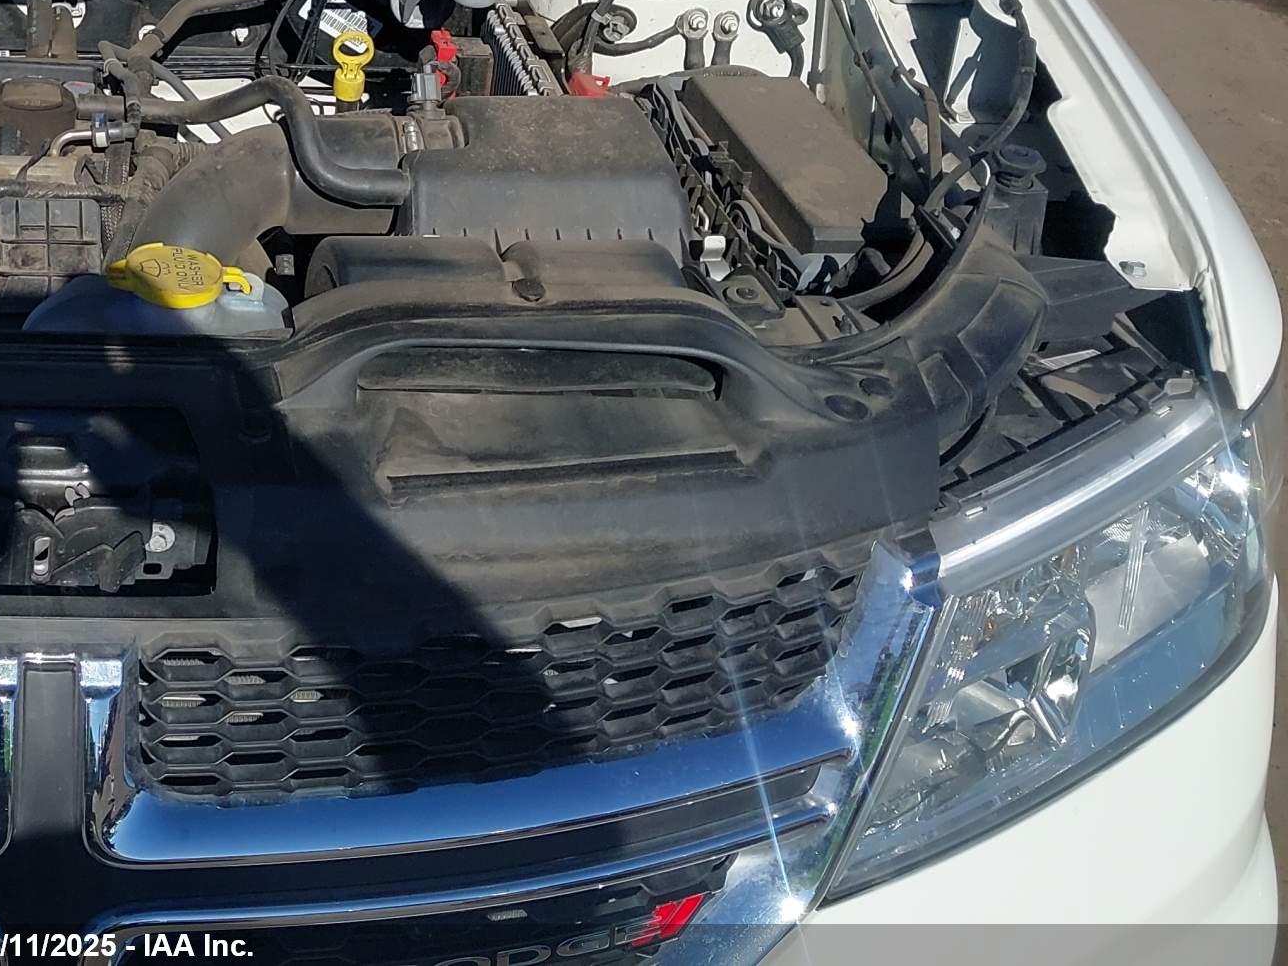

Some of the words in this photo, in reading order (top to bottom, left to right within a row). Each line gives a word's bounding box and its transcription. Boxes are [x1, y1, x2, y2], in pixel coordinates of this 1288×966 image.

[172, 248, 187, 270] FLUID
[187, 254, 204, 286] WASHER
[175, 270, 190, 291] ONLY
[400, 916, 662, 966] DGE
